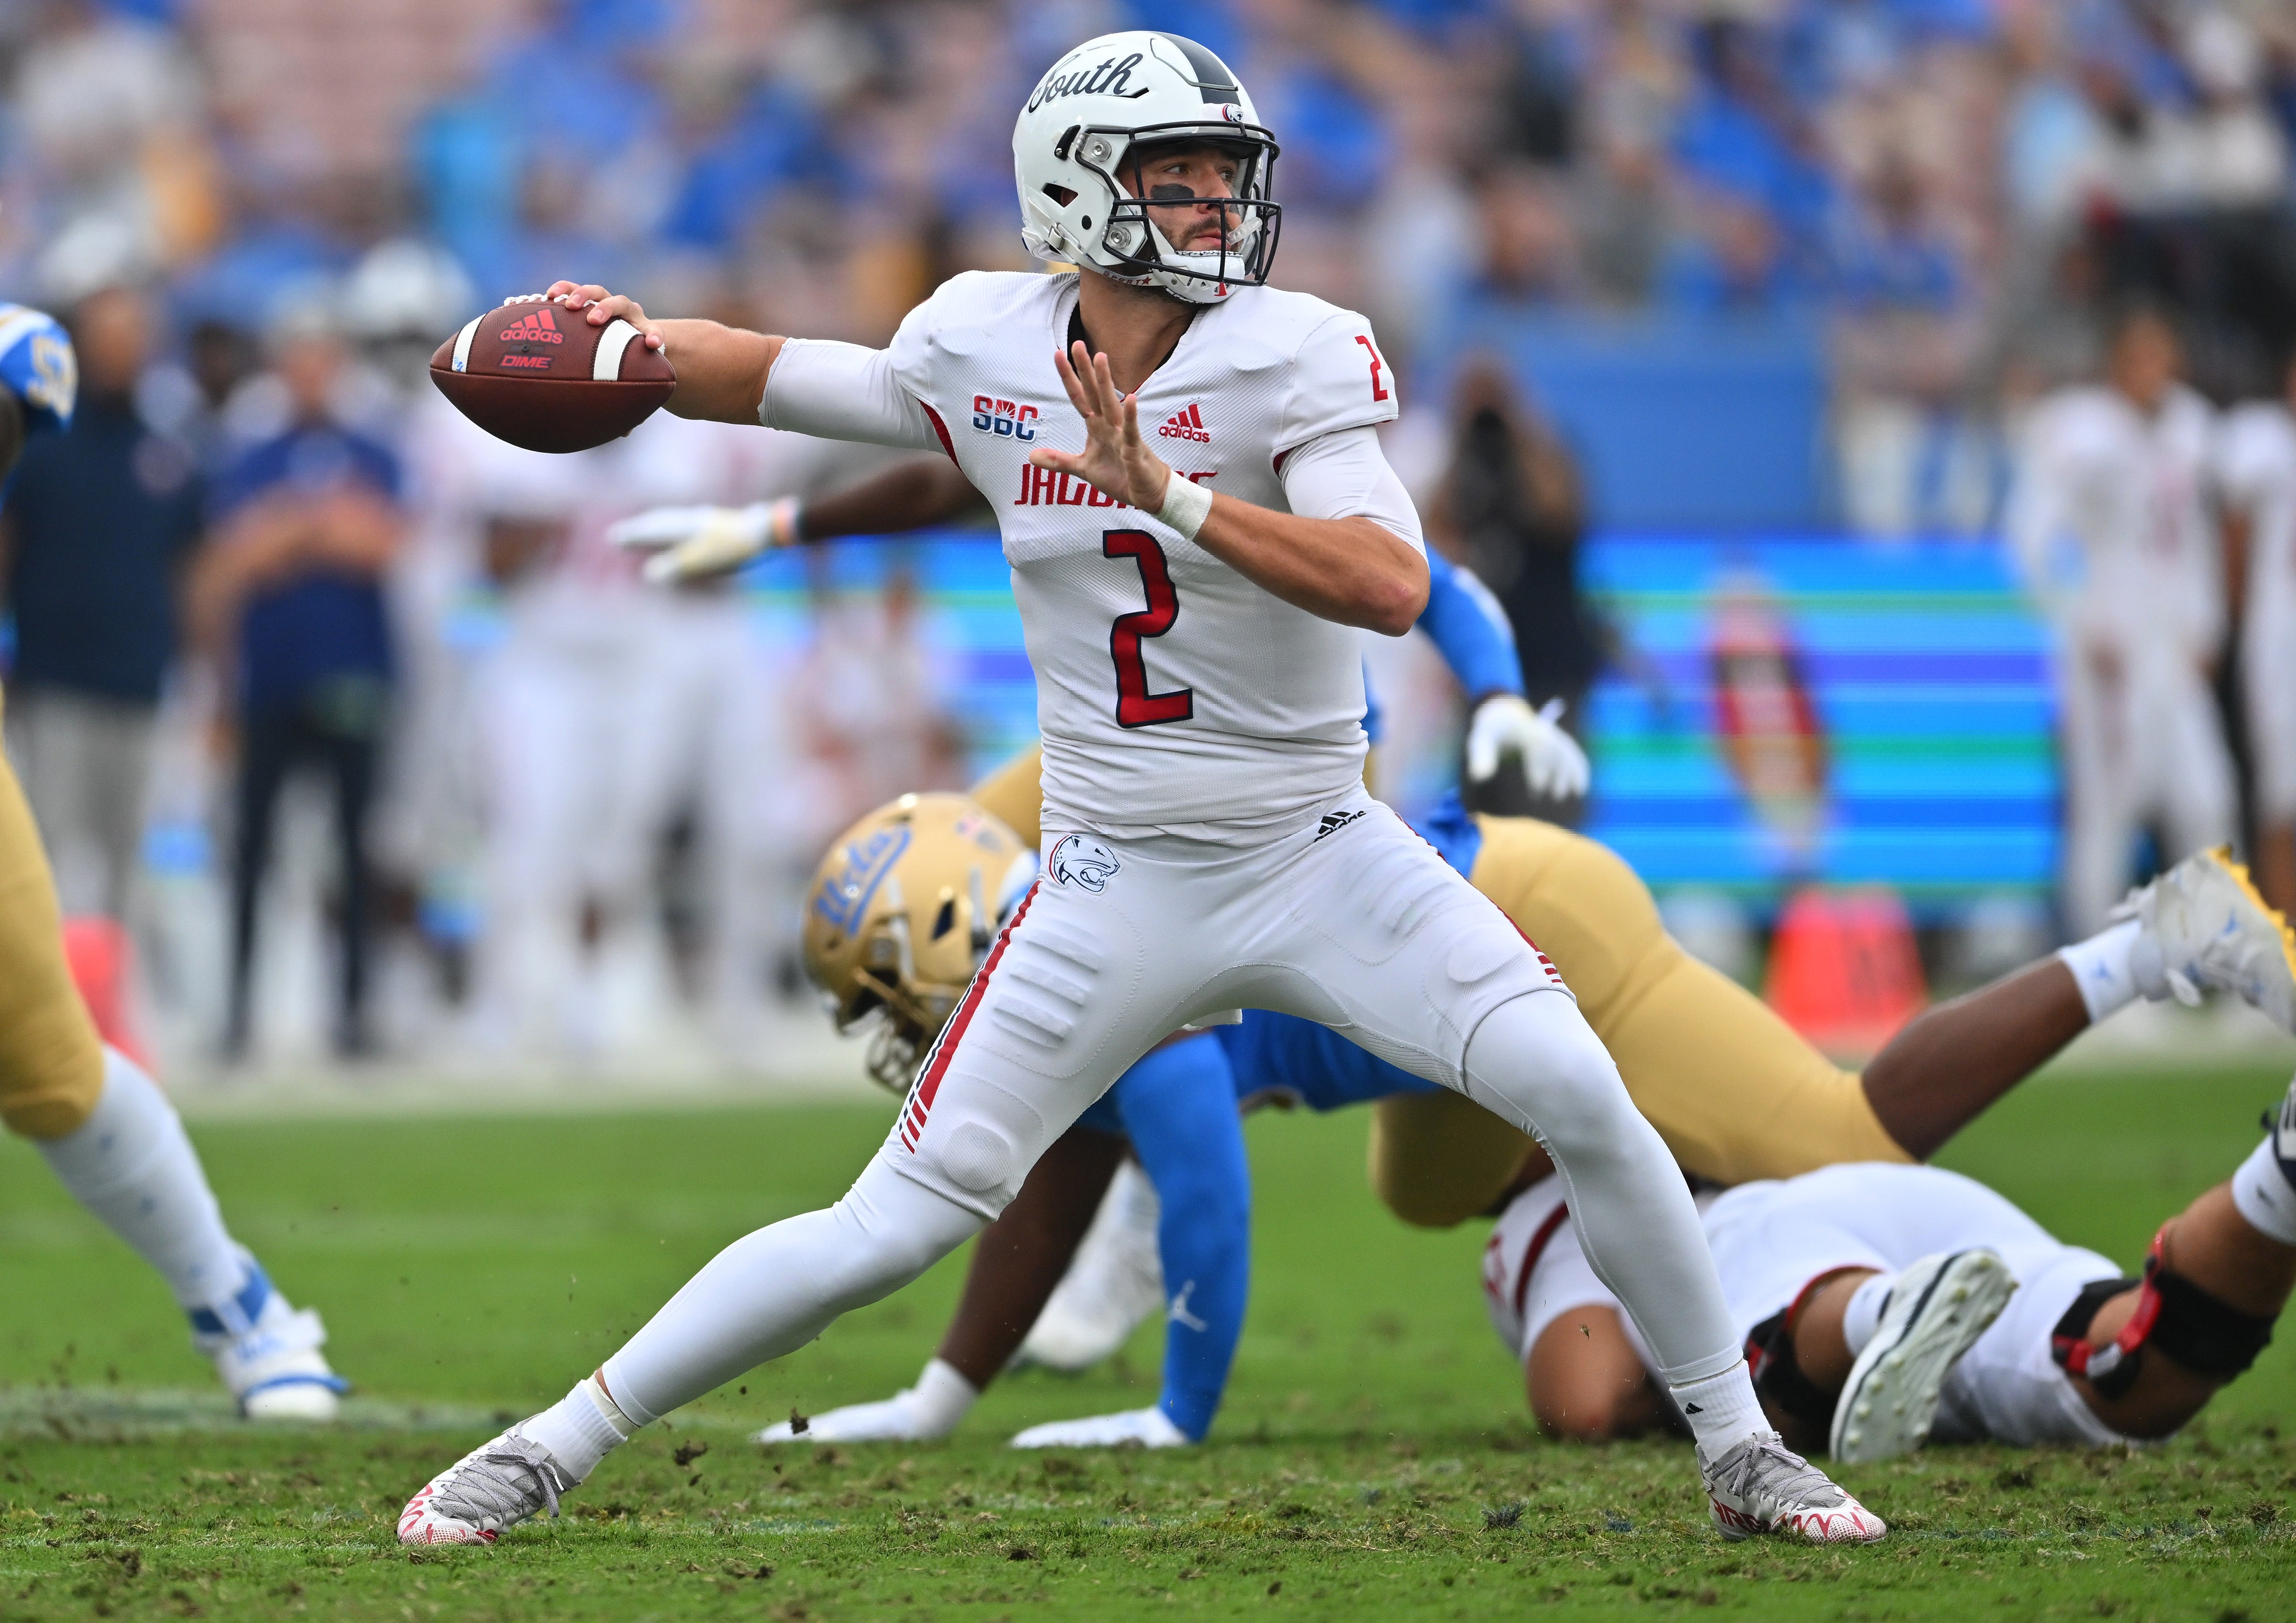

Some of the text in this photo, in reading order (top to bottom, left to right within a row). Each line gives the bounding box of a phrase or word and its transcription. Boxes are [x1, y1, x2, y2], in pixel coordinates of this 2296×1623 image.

[1028, 53, 1144, 113] South
[1103, 270, 1142, 285] SPORT
[500, 327, 563, 344] adidas
[501, 355, 552, 368] DIME
[1355, 335, 1388, 402] 2
[973, 395, 1038, 442] SBC
[1159, 424, 1211, 443] adidas
[1103, 529, 1193, 729] 2
